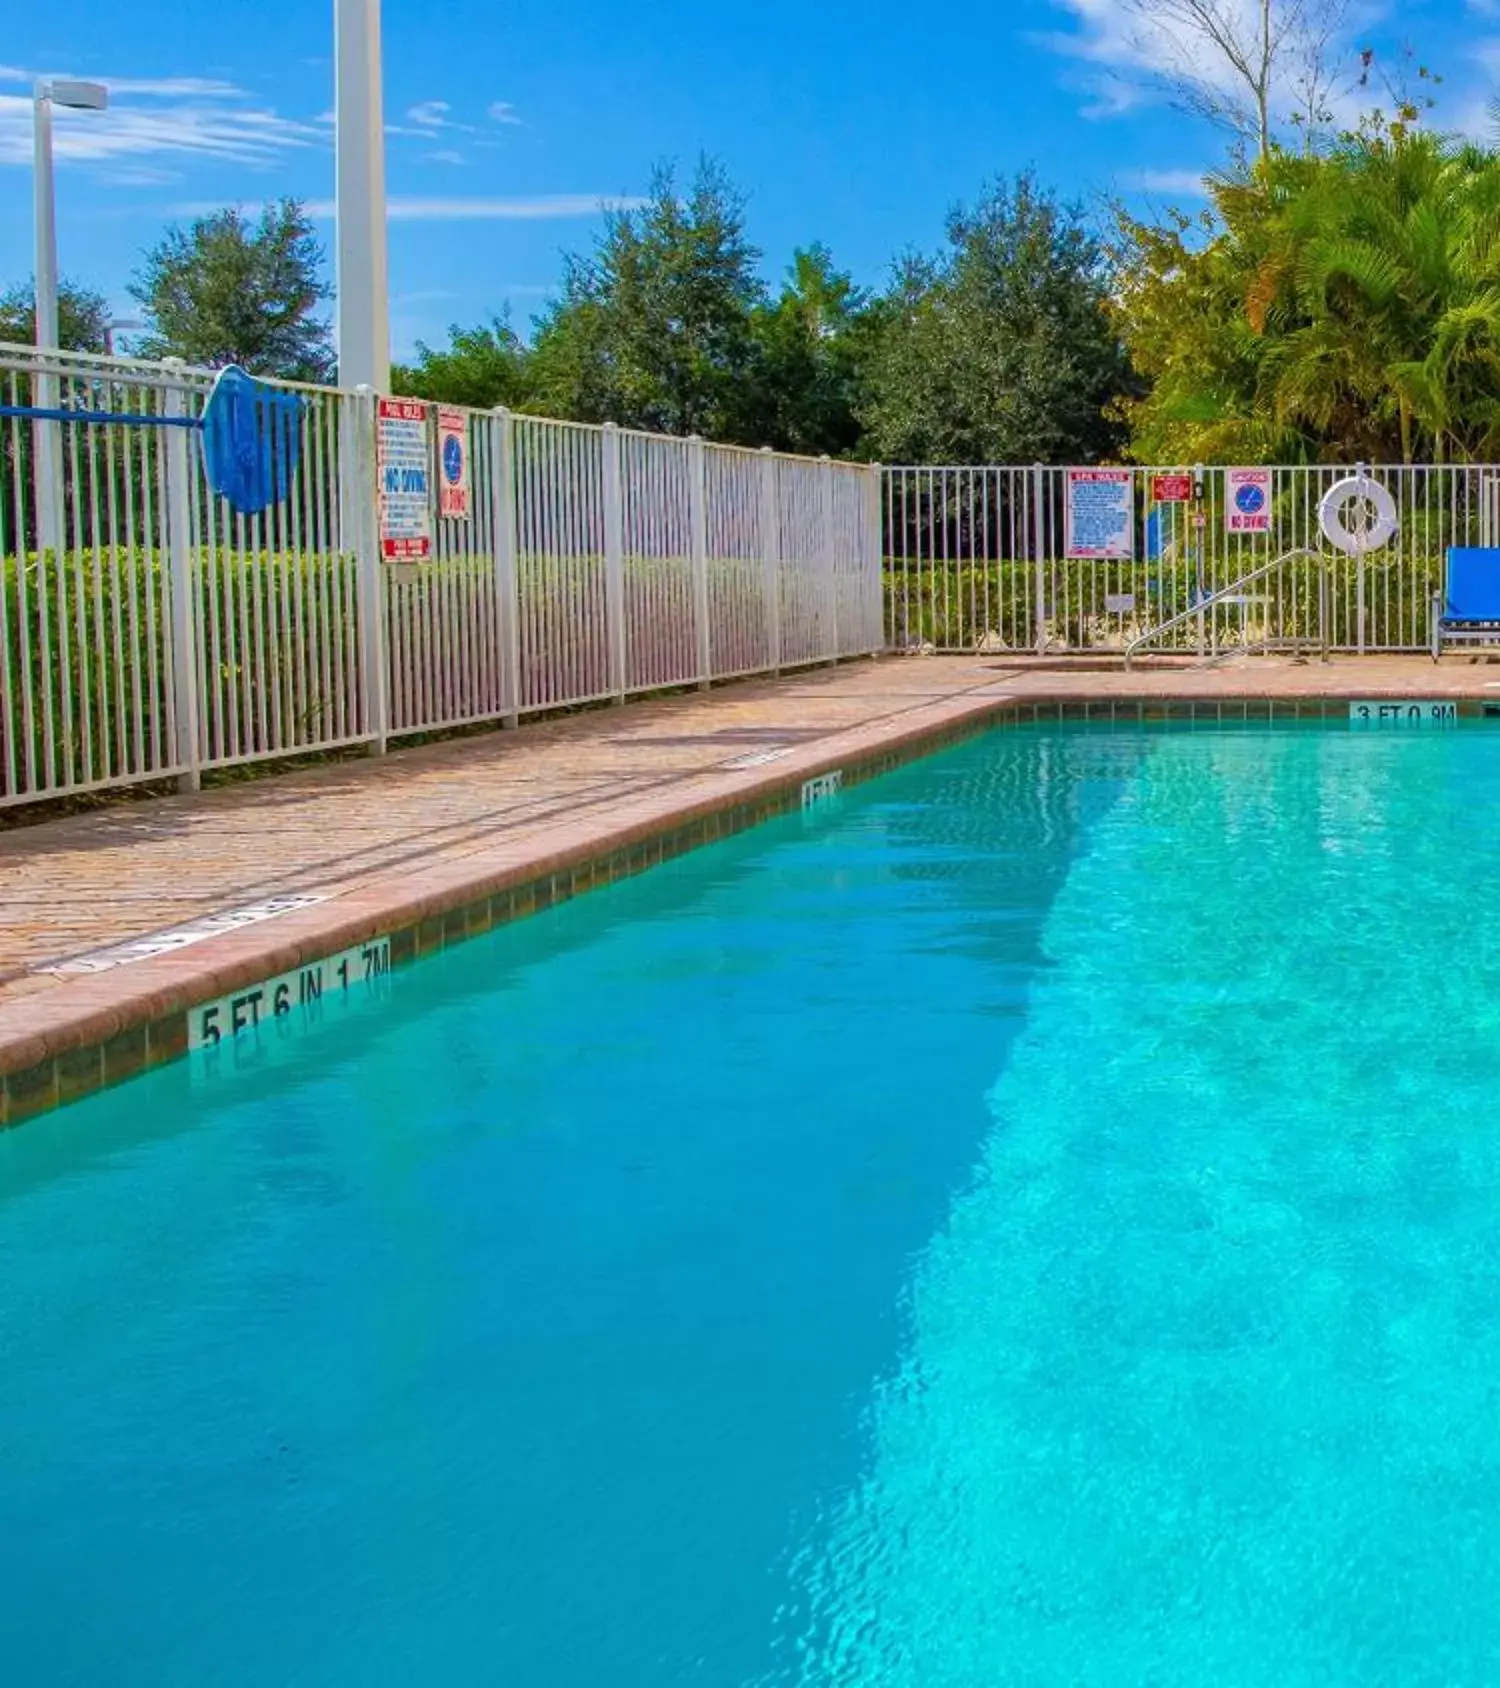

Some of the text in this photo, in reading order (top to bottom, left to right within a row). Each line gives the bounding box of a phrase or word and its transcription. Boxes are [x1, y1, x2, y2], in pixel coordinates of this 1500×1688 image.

[1231, 515, 1268, 528] NO DIVING
[1358, 705, 1369, 719] 3
[1379, 705, 1402, 719] FT
[1431, 705, 1455, 719] 9M
[203, 943, 388, 1049] 5 FT 6 IN 1 7M
